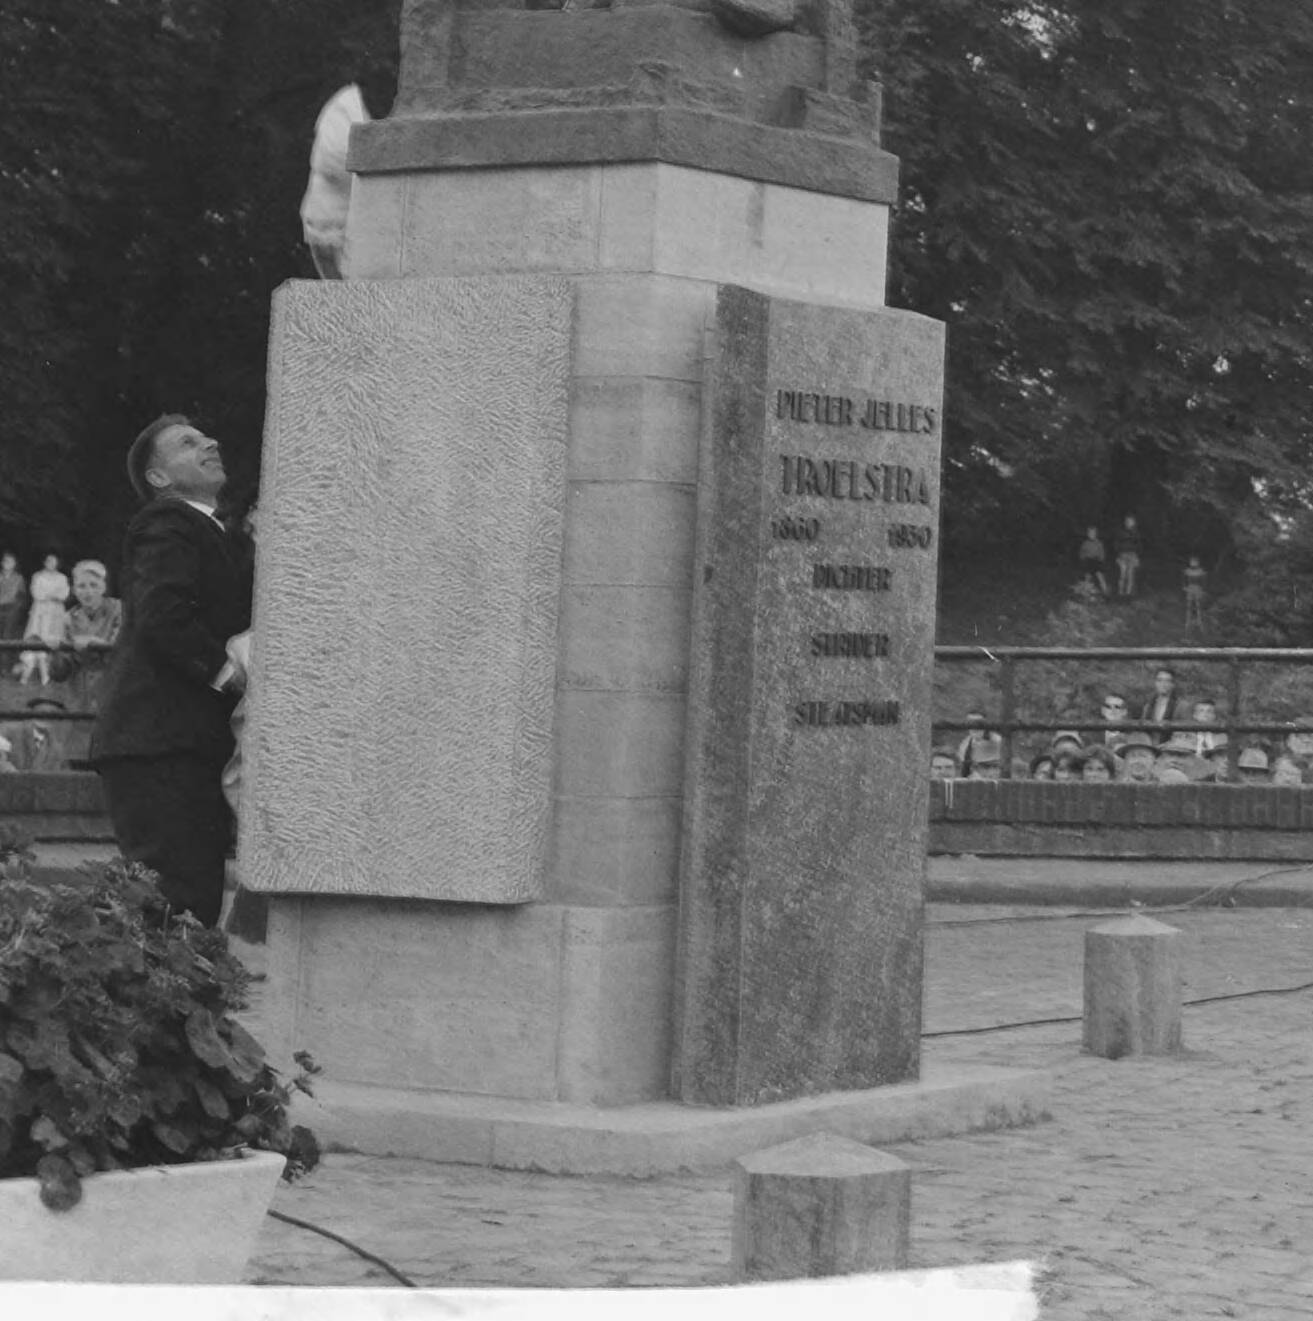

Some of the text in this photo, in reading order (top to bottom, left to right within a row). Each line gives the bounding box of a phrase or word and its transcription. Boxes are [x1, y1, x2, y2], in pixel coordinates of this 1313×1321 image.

[776, 389, 936, 434] PIETER JELLES
[779, 454, 930, 505] TROELSTRA
[771, 516, 820, 541] 1860
